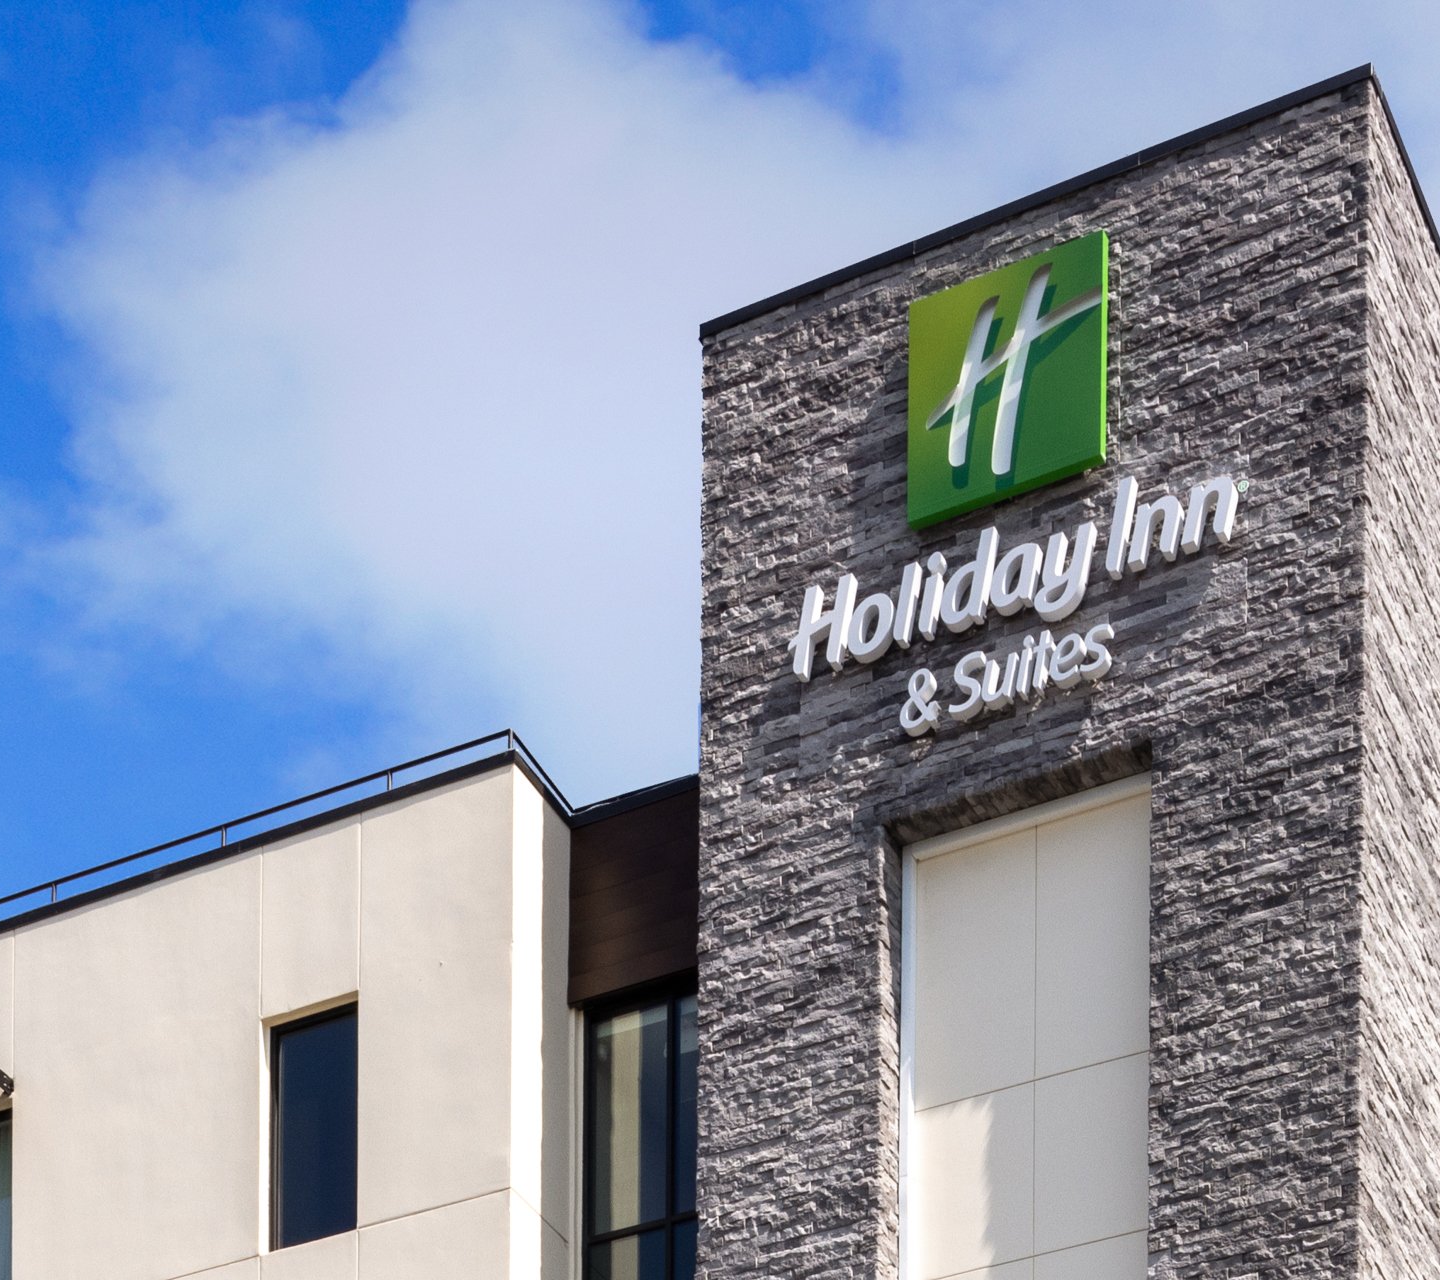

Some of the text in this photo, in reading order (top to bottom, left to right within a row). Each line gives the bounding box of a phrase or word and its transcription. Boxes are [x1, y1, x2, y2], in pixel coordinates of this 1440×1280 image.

[926, 262, 1102, 475] H
[787, 476, 1239, 682] Holiday Inn
[900, 623, 1114, 737] & Suites
